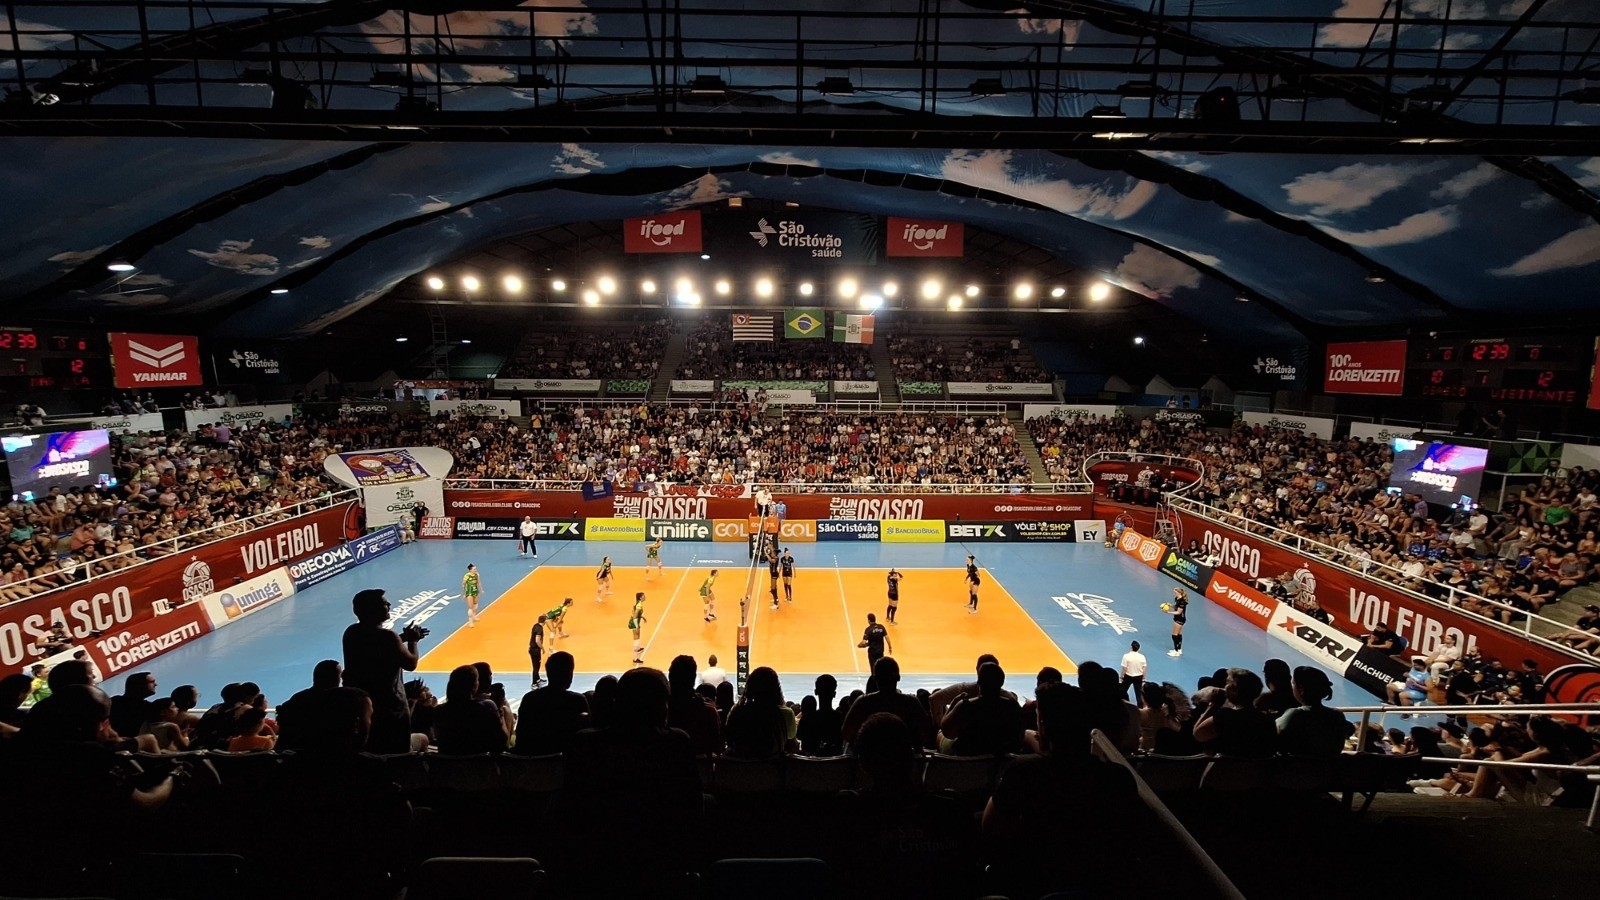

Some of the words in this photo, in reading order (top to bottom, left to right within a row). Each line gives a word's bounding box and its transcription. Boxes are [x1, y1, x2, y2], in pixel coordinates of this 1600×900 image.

[640, 220, 686, 236] ifood
[779, 221, 804, 234] São
[903, 224, 948, 240] ifood
[779, 233, 842, 248] Cristóvão
[812, 247, 842, 258] saúde
[244, 351, 258, 360] São
[245, 358, 279, 368] Cristóvão
[1266, 357, 1278, 366] São
[133, 372, 187, 381] YANMAR
[1266, 364, 1296, 374] Cristóvão
[1328, 369, 1400, 383] LORENZETTI
[642, 497, 707, 519] OSASCO
[858, 499, 923, 520] OSASCO
[457, 522, 485, 532] CRAVADA
[536, 523, 579, 534] ET7K
[650, 523, 709, 538] unilife
[715, 523, 748, 537] GOL
[781, 523, 814, 537] GOL
[950, 525, 1006, 537] BET7K
[1015, 522, 1037, 530] VÔLEI
[1084, 531, 1097, 540] EY
[240, 523, 324, 574] VOLEIBOL
[1204, 530, 1260, 578] OSASCO
[298, 547, 352, 575] RECOMA
[1178, 558, 1198, 574] CANAL
[182, 578, 214, 602] OSASCO
[236, 579, 281, 608] uningá
[1226, 588, 1272, 617] YANMAR
[1051, 596, 1099, 627] BET7K
[0, 586, 132, 666] OSASCO
[130, 632, 150, 645] ANOS
[1276, 616, 1358, 662] XBRI
[106, 621, 200, 672] LORENZETTI
[1353, 659, 1396, 684] RIACHUEL
